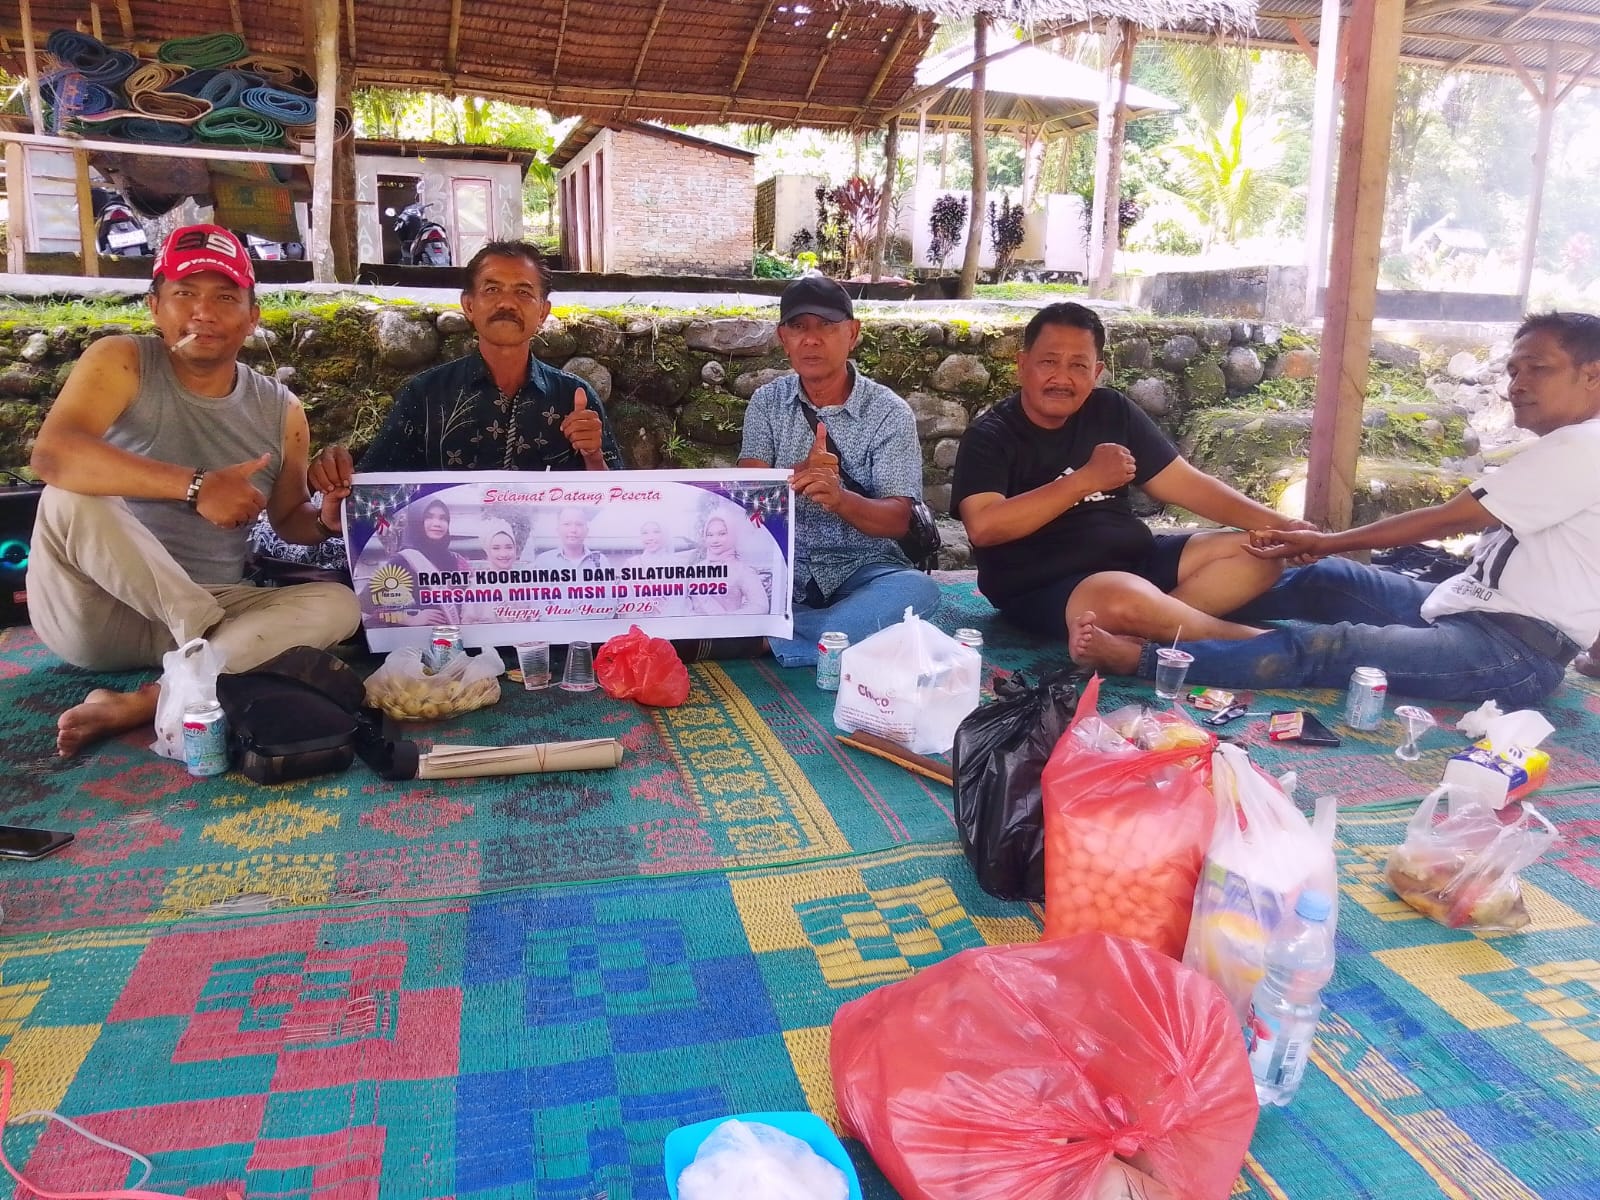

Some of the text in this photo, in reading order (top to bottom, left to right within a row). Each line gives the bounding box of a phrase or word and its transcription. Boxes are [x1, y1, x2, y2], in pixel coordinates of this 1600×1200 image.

[483, 487, 661, 504] Selamat Datang Peserta
[418, 565, 728, 586] RAPAT KOORDINASI DAN SILATURAHMI
[420, 582, 728, 604] BERSAMA MITRA MSN ID TAHUN 2026
[545, 604, 576, 616] New
[578, 603, 613, 615] Year
